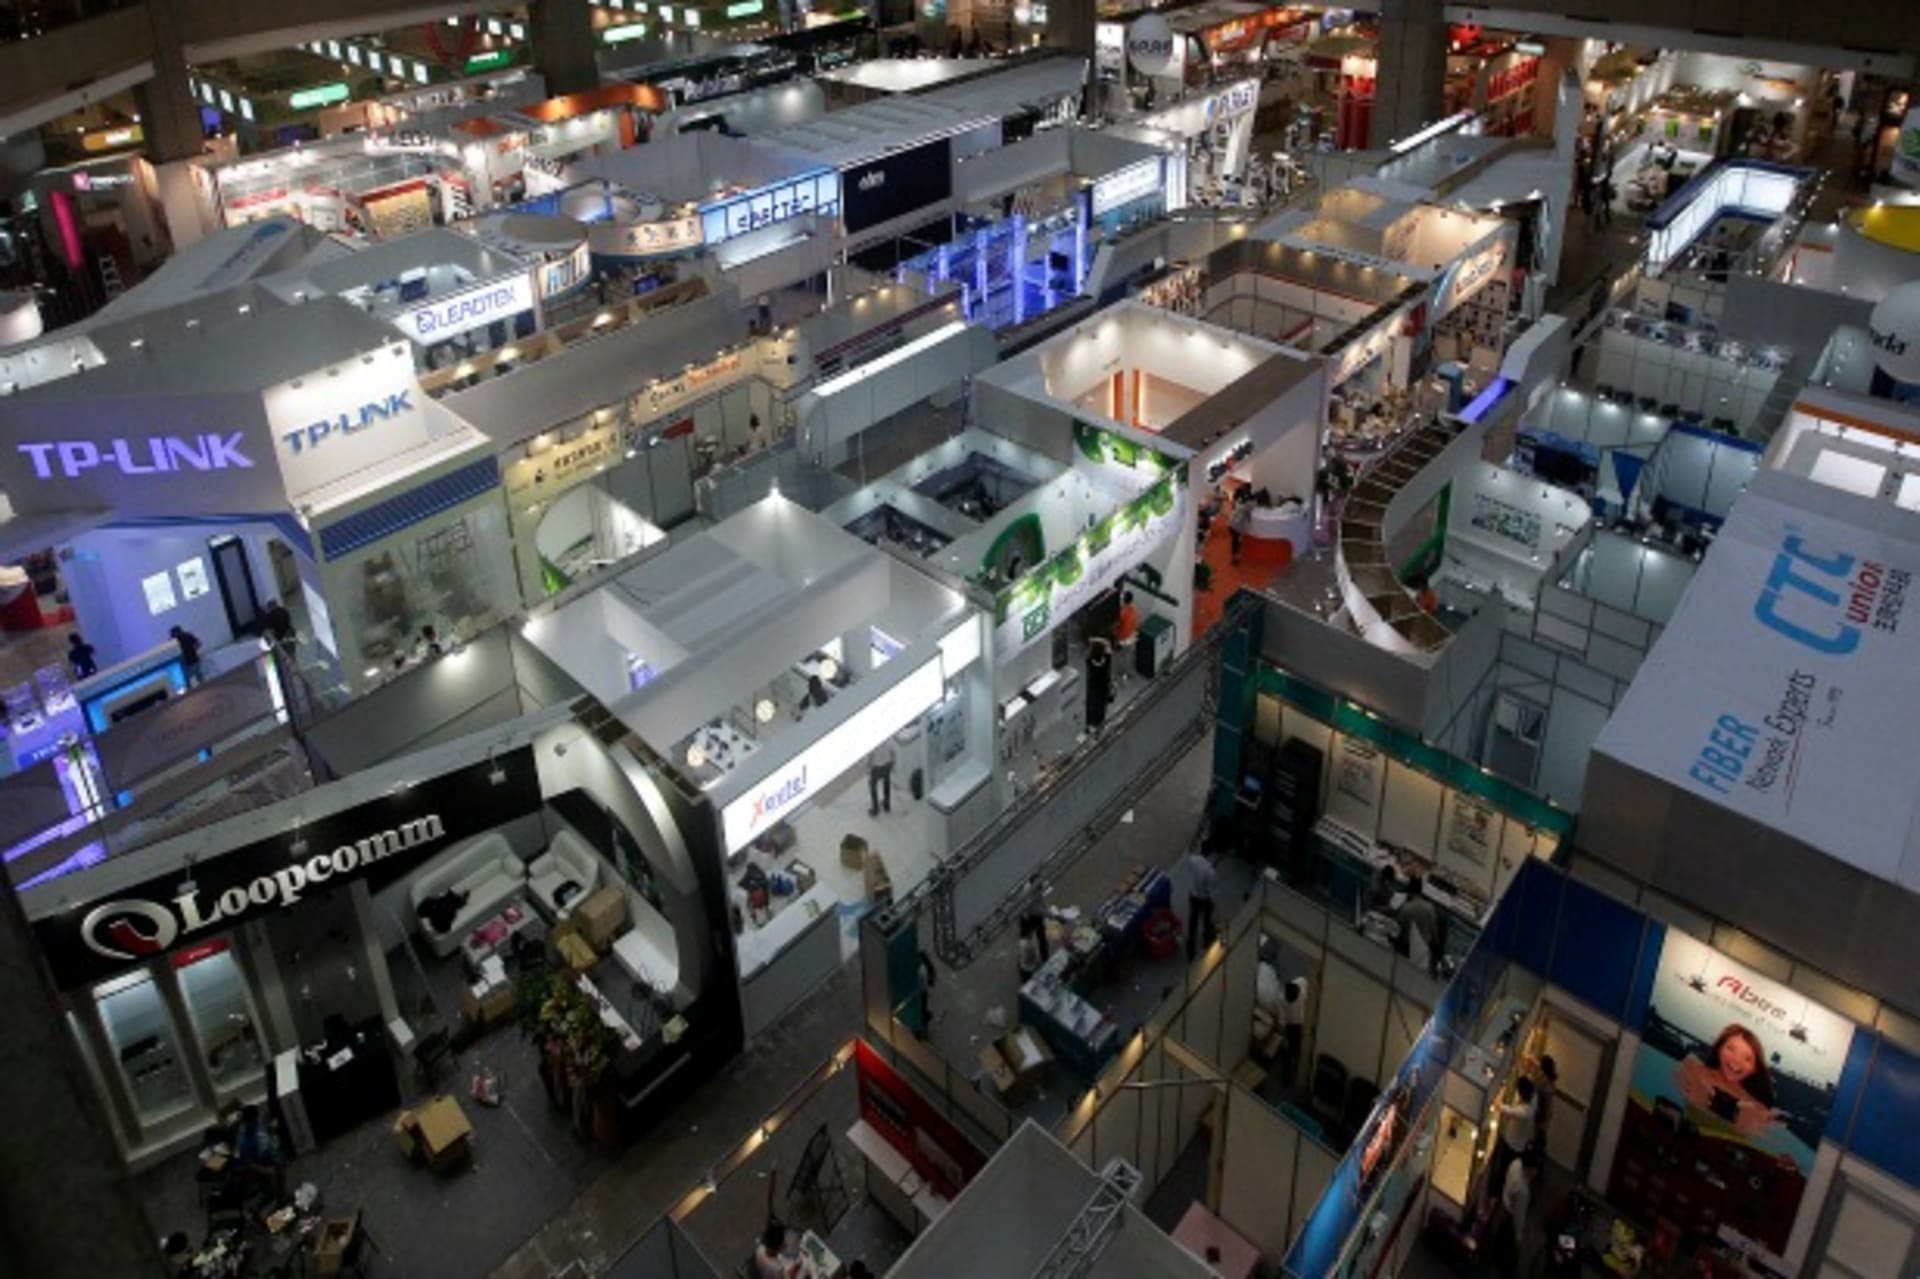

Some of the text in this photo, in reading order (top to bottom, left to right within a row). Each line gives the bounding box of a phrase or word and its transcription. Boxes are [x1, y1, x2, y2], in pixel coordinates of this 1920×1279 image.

[17, 431, 255, 478] TP-LINK
[282, 390, 414, 456] TP-LINK
[1754, 533, 1863, 654] CTC
[1763, 668, 1816, 736] Experts
[1689, 713, 1761, 794] FIBER
[172, 814, 446, 936] Loopcomm
